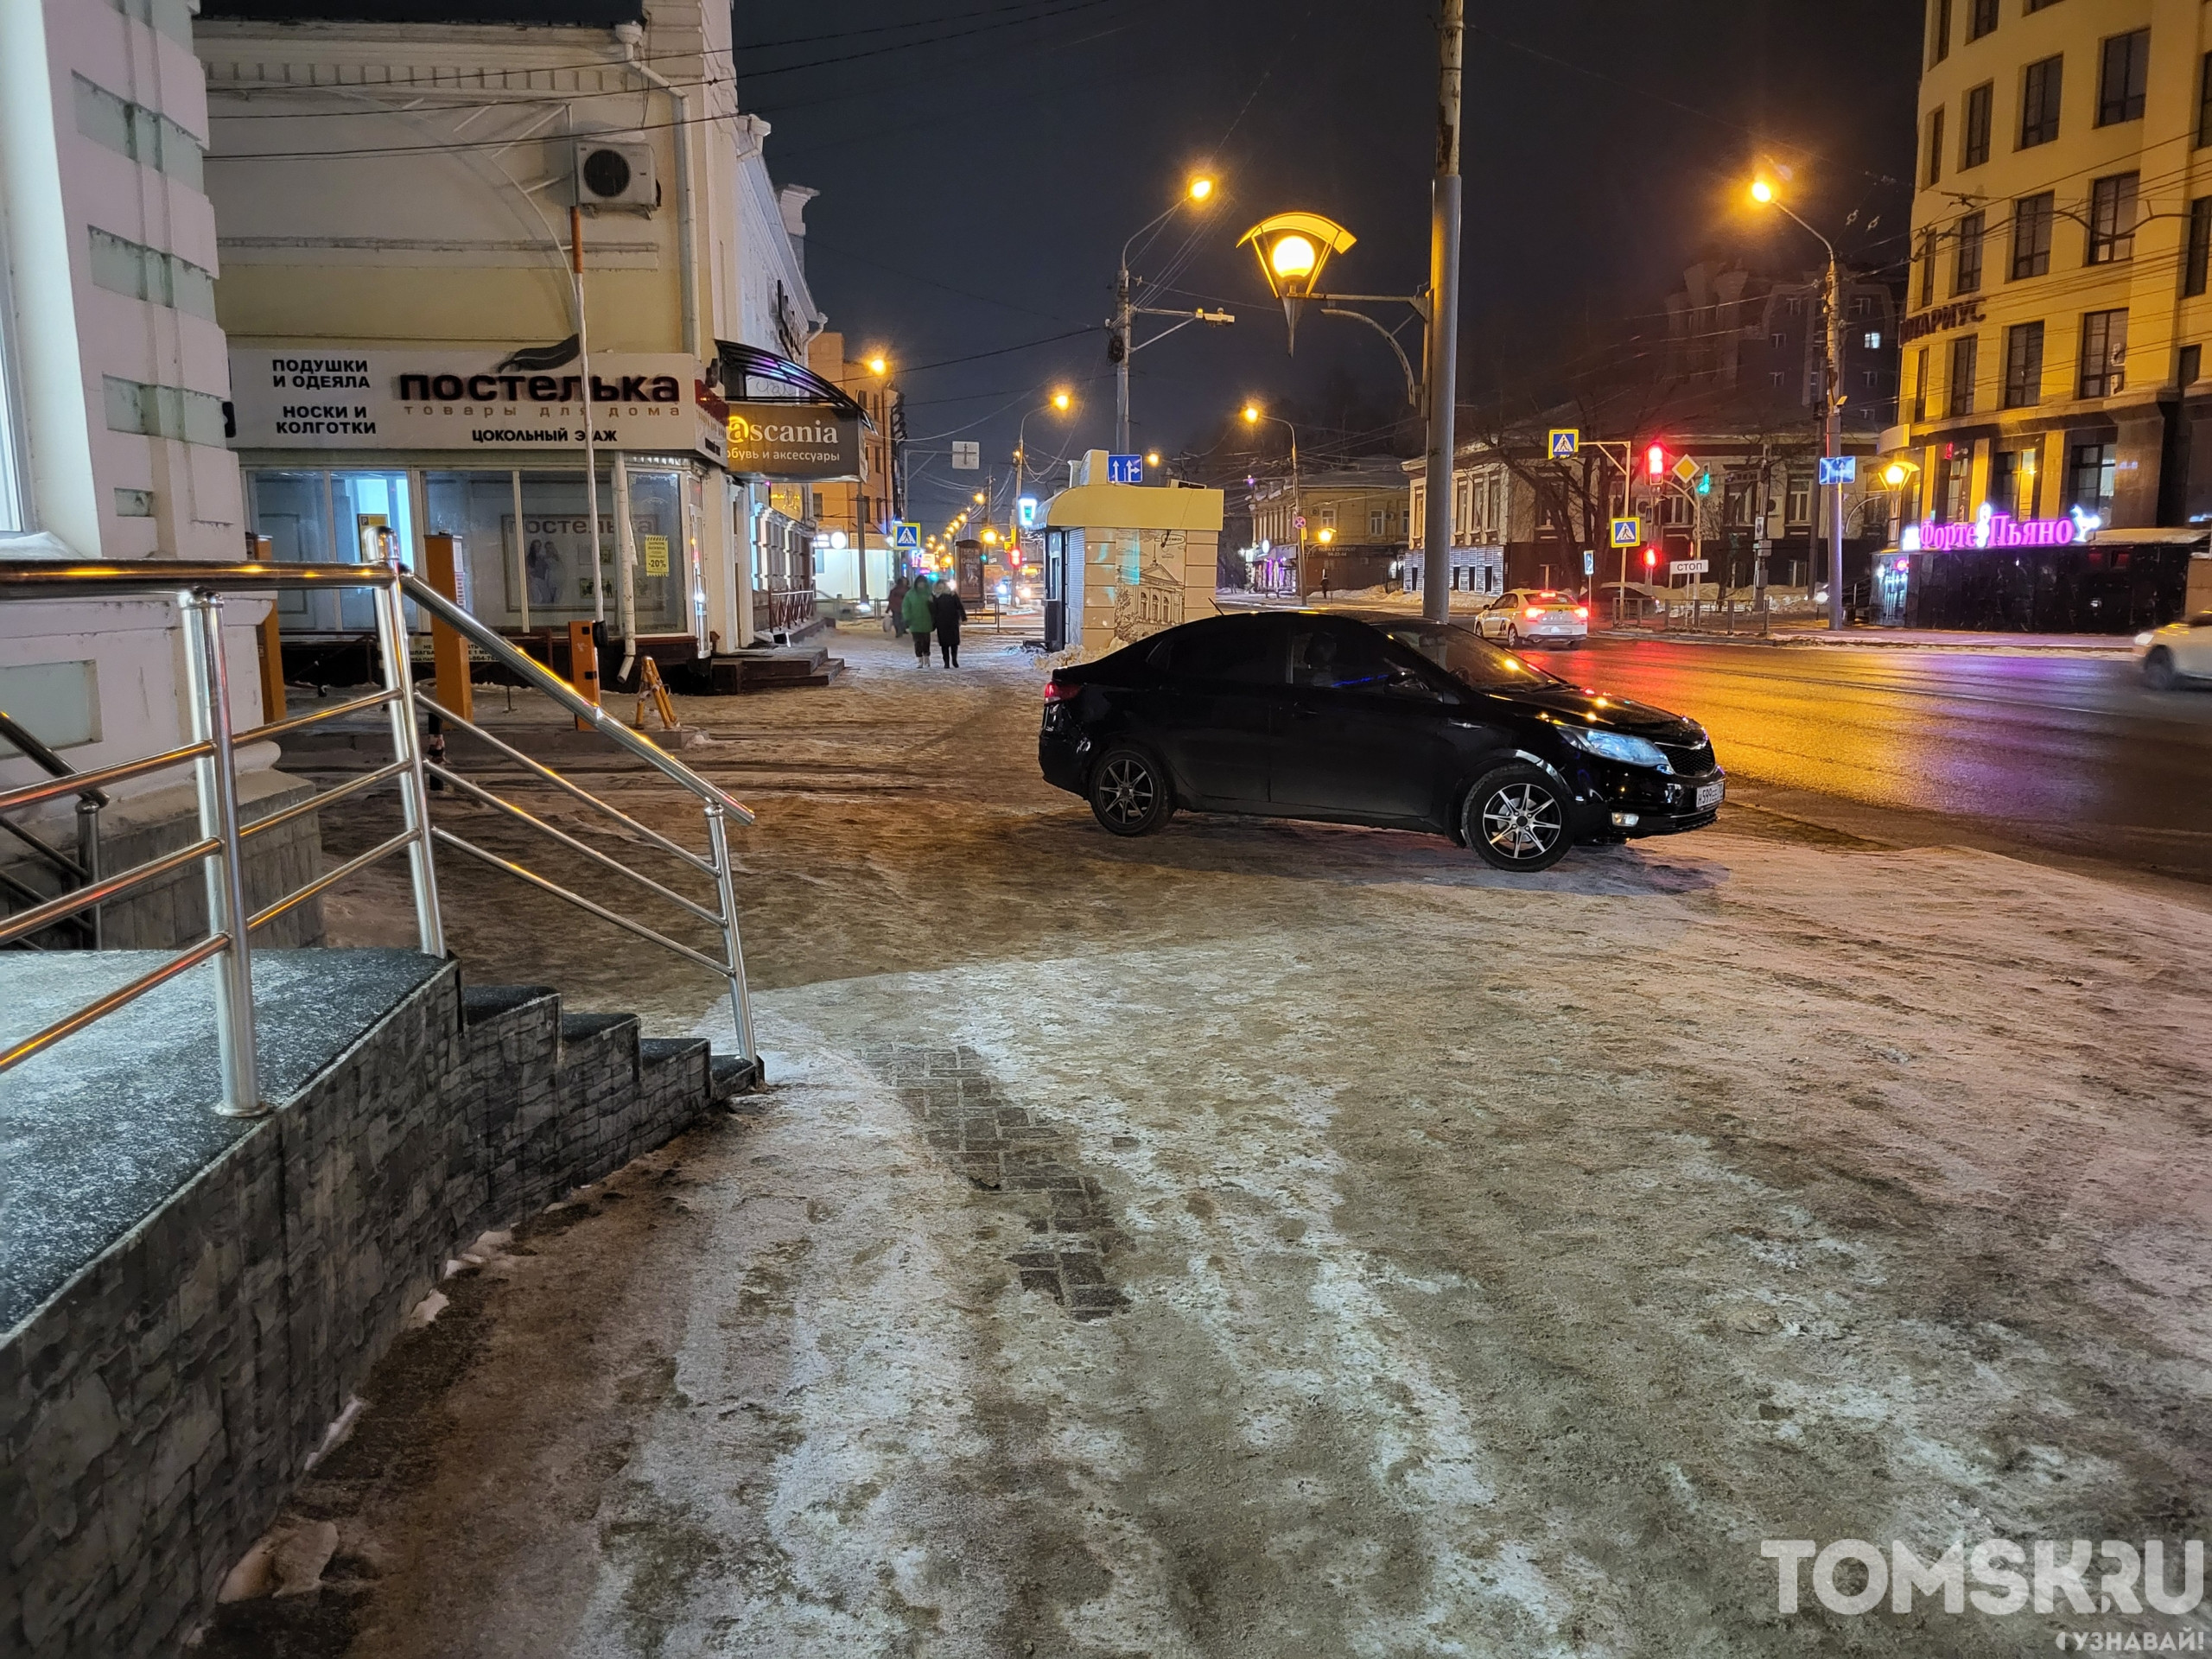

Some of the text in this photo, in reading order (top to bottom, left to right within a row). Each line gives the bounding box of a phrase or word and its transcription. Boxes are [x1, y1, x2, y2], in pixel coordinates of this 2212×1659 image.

[272, 359, 368, 374] ПОДУШКИ
[273, 375, 371, 390] И ОДЕЯЛА
[283, 405, 367, 418] НОСКИ И
[404, 406, 516, 418] товары
[609, 407, 680, 418] дома
[276, 422, 376, 434] КОЛГОТКИ
[472, 428, 618, 442] ЦОКОЛЬНЫЙ ЭАЖ
[762, 451, 770, 460] и
[773, 451, 840, 462] аксессуары
[1677, 563, 1702, 571] СТОП
